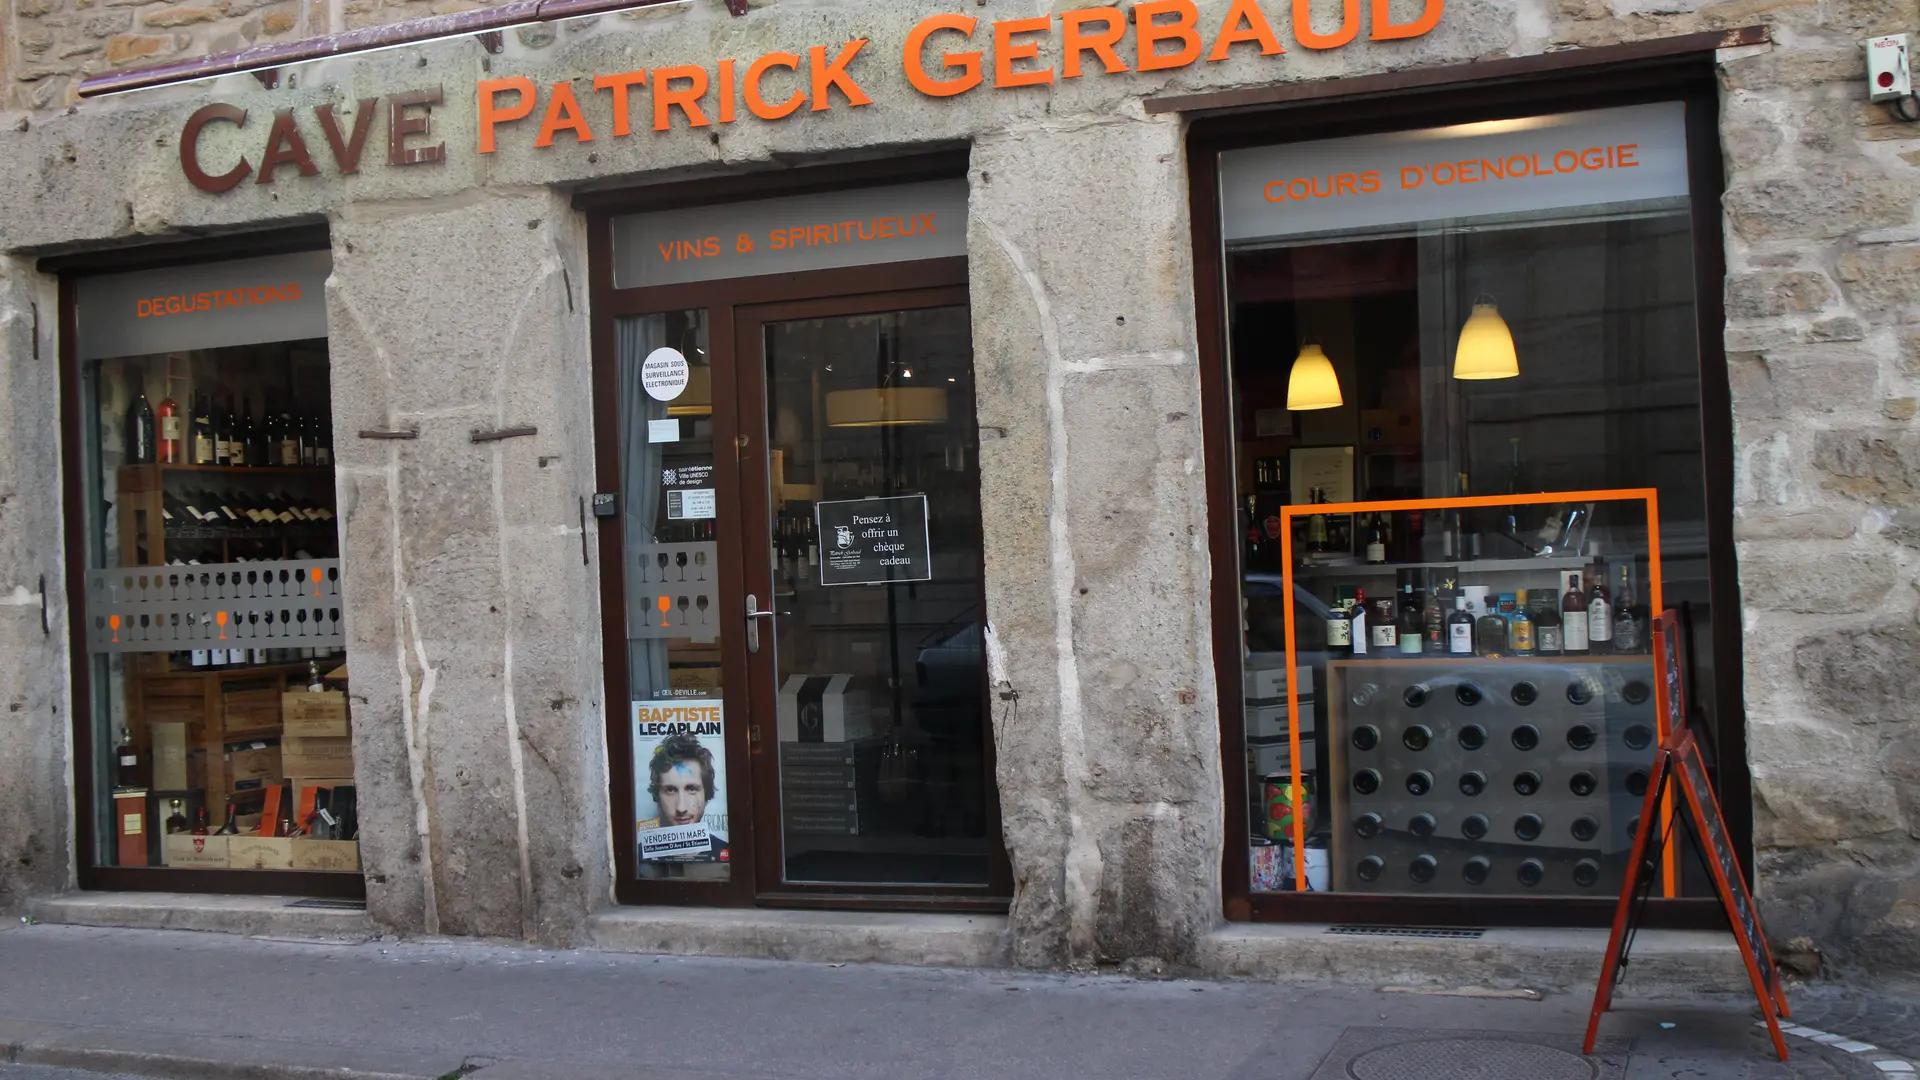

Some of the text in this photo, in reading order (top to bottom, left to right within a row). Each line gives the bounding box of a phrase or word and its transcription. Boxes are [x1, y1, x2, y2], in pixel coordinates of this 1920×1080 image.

[1874, 40, 1899, 48] NEON
[180, 0, 1445, 193] CAVE PATRICK GERBAUD
[1263, 143, 1640, 203] COURS D'OENOLOGIE
[658, 213, 937, 262] VINS & SPIRITUEUX
[137, 282, 302, 318] DEGUSTATIONS
[645, 360, 685, 370] MAGASIN SOUS
[645, 370, 685, 379] SURVEILLANCE
[645, 379, 685, 388] ELECTRONIQUE
[853, 513, 891, 524] Pensez à
[862, 528, 899, 538] offrir un
[873, 542, 905, 554] chèque
[879, 555, 911, 566] cadeau
[638, 707, 720, 722] BAPTISTE
[639, 722, 721, 736] LECAPLAIN
[643, 829, 707, 844] VENDREDI 11 MARS
